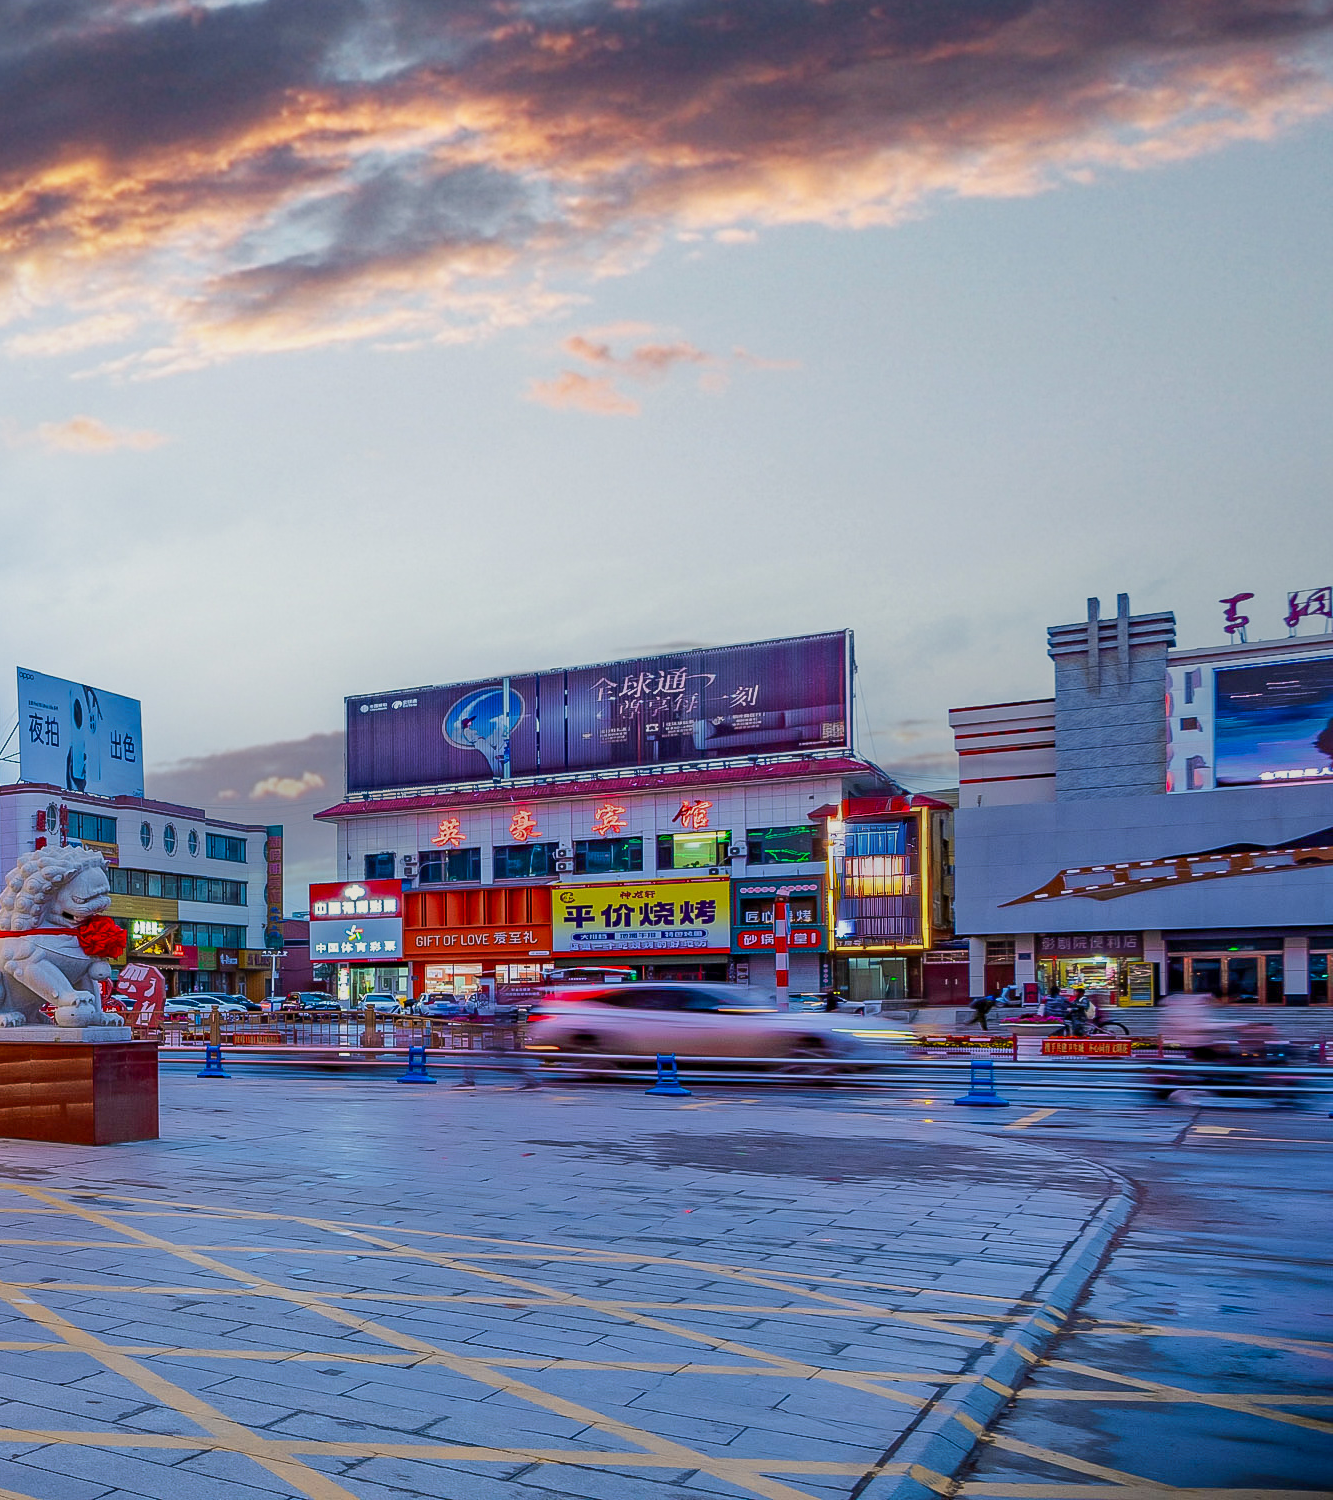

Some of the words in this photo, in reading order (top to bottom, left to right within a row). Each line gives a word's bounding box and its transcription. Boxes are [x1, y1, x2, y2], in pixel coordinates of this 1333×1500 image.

[589, 667, 716, 700] 全球通
[28, 712, 59, 747] 夜拍
[110, 729, 135, 762] 出色
[431, 800, 713, 847] 英豪宾馆
[563, 899, 717, 929] 平价烧烤
[315, 940, 397, 953] 中国体育彩票
[416, 935, 440, 947] GIFT
[443, 934, 457, 946] OF
[460, 933, 489, 945] LOVE
[493, 931, 538, 944] 爱至礼
[1041, 935, 1138, 950] 影剧院便利店
